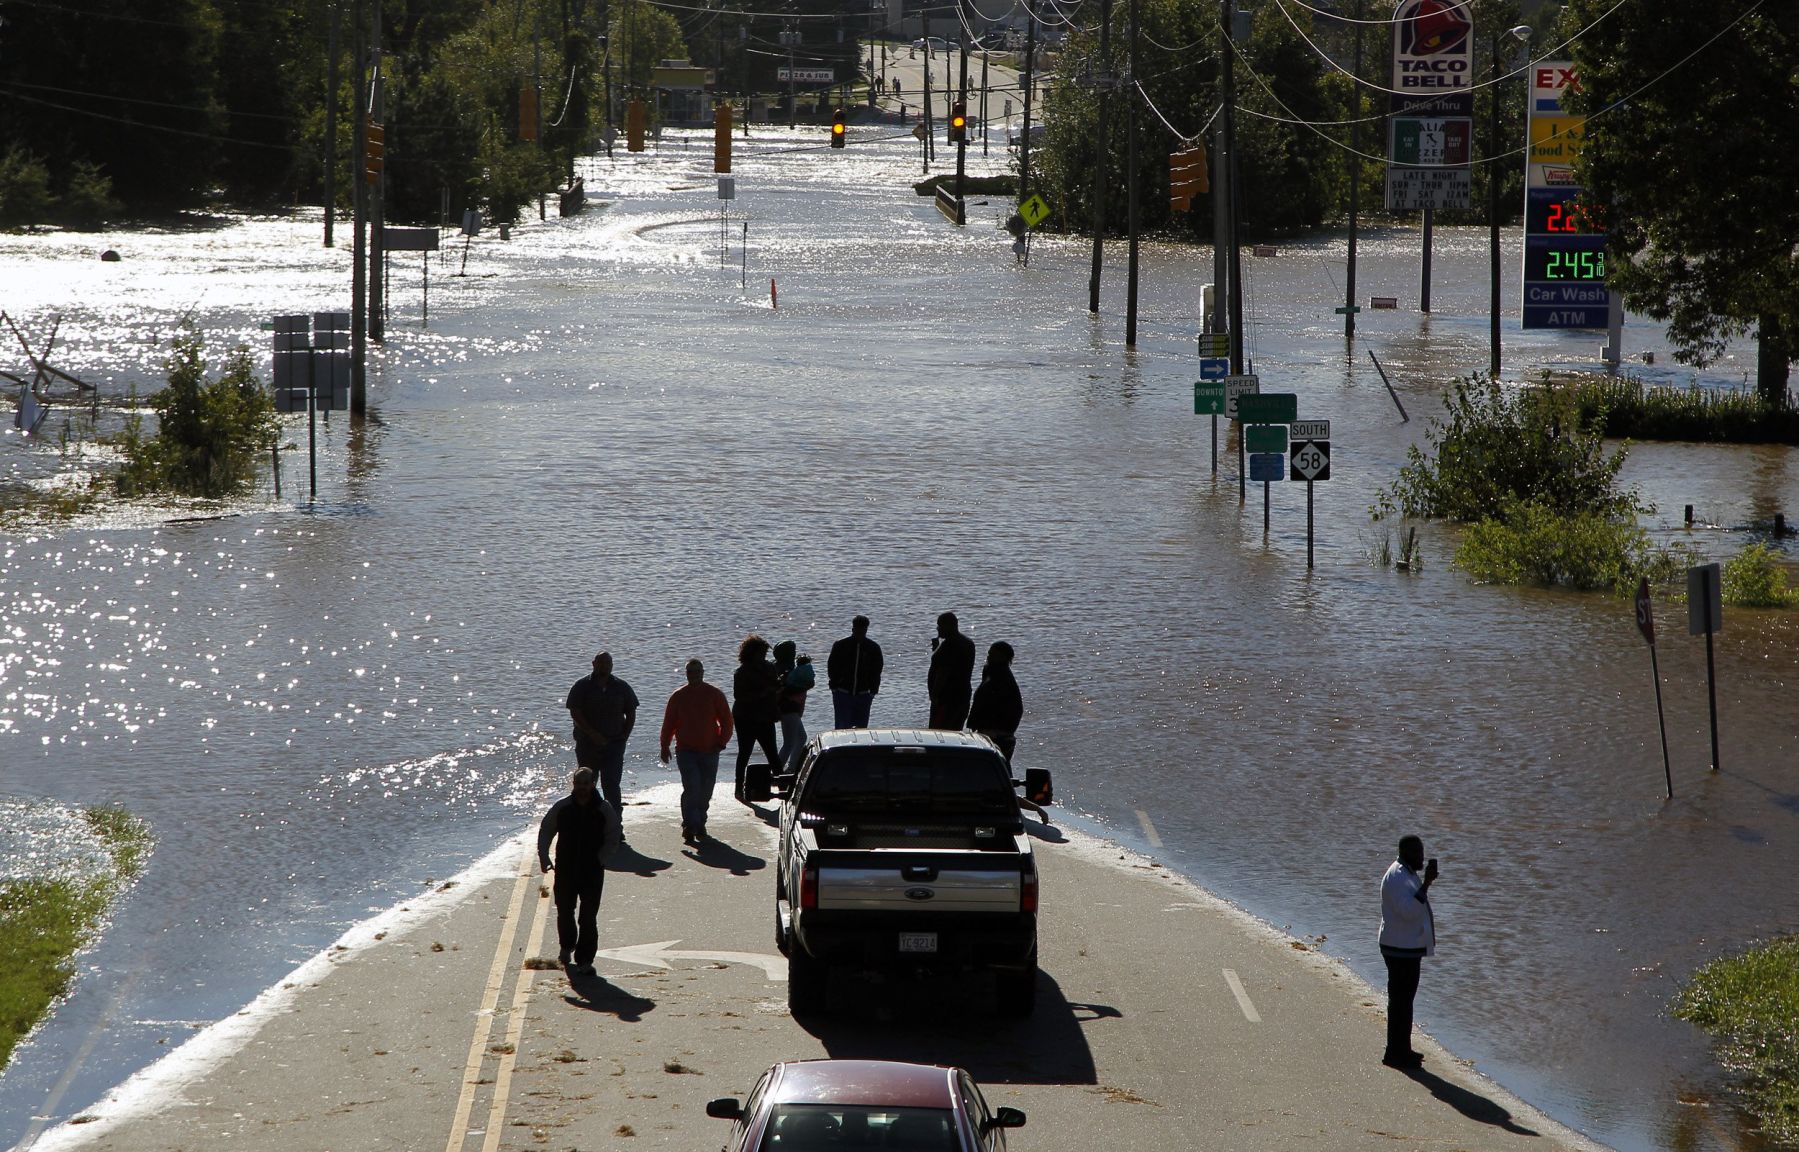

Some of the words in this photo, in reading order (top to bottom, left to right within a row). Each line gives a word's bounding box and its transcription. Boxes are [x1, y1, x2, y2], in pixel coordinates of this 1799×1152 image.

[1399, 60, 1468, 73] TACO
[1402, 75, 1468, 87] BELL
[1536, 64, 1584, 93] EX
[1404, 101, 1432, 110] Drive
[1435, 101, 1460, 110] Thru
[1403, 171, 1426, 179] LATE
[1432, 171, 1458, 179] NIGHT
[1392, 181, 1409, 189] SUN
[1420, 181, 1443, 189] THUR
[1393, 190, 1407, 198] FRI
[1418, 190, 1434, 199] SAT
[1447, 190, 1469, 199] 12AM
[1413, 200, 1436, 208] TACO
[1442, 200, 1464, 208] BELL
[1547, 252, 1594, 278] 2.45
[1530, 287, 1556, 300] Car
[1562, 287, 1606, 300] Wash
[1547, 311, 1586, 324] ATM
[1196, 387, 1224, 396] DOWNTO
[1230, 388, 1252, 396] LIMIT
[1229, 397, 1238, 413] 3
[1292, 424, 1327, 436] SOUTH
[1300, 452, 1321, 470] 58
